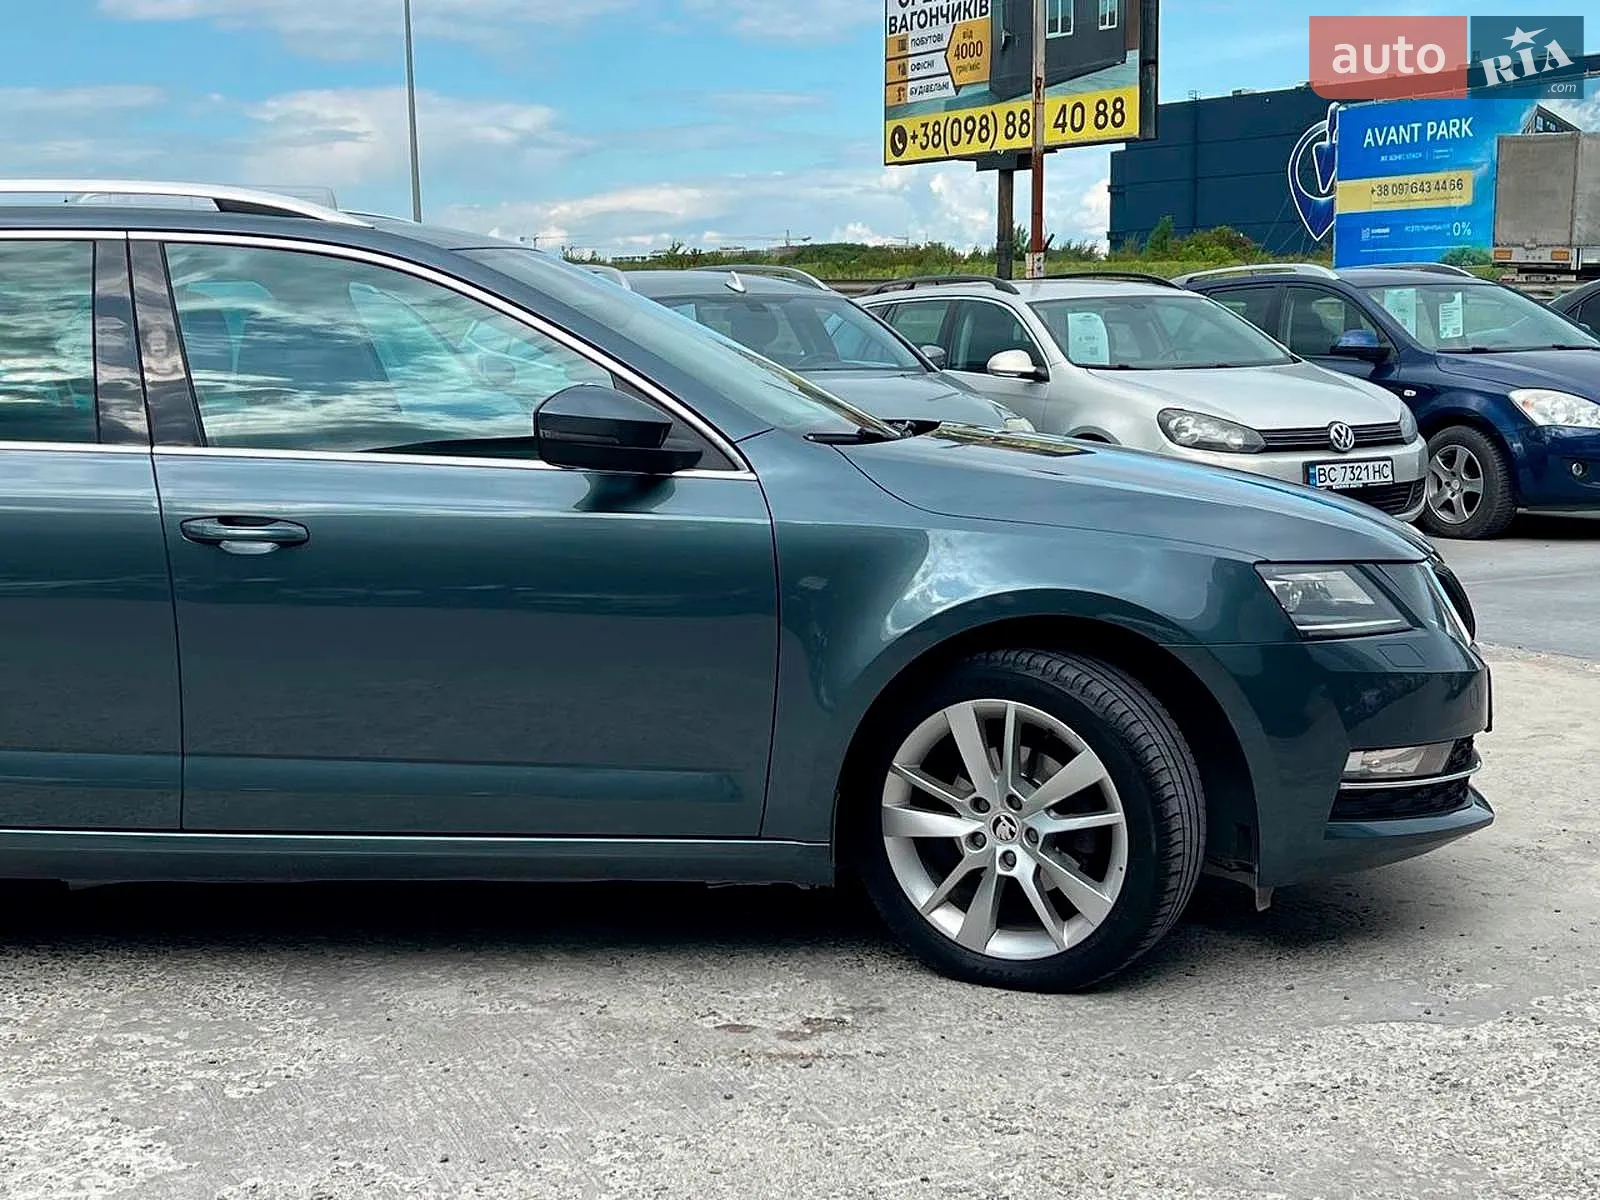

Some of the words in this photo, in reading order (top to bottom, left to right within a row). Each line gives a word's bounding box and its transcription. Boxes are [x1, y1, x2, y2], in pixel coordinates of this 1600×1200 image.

[889, 0, 989, 35] ВАГОНЧИКІВ
[954, 40, 983, 60] 4000
[910, 111, 998, 154] +38(098)
[1053, 102, 1086, 134] 40
[1094, 96, 1126, 129] 88
[1363, 122, 1422, 148] AVANT
[1426, 116, 1474, 142] PARK
[1371, 183, 1389, 196] +38
[1452, 221, 1472, 236] 0%
[1317, 466, 1337, 483] BC
[1340, 465, 1370, 481] 7321
[1372, 463, 1390, 479] HC
